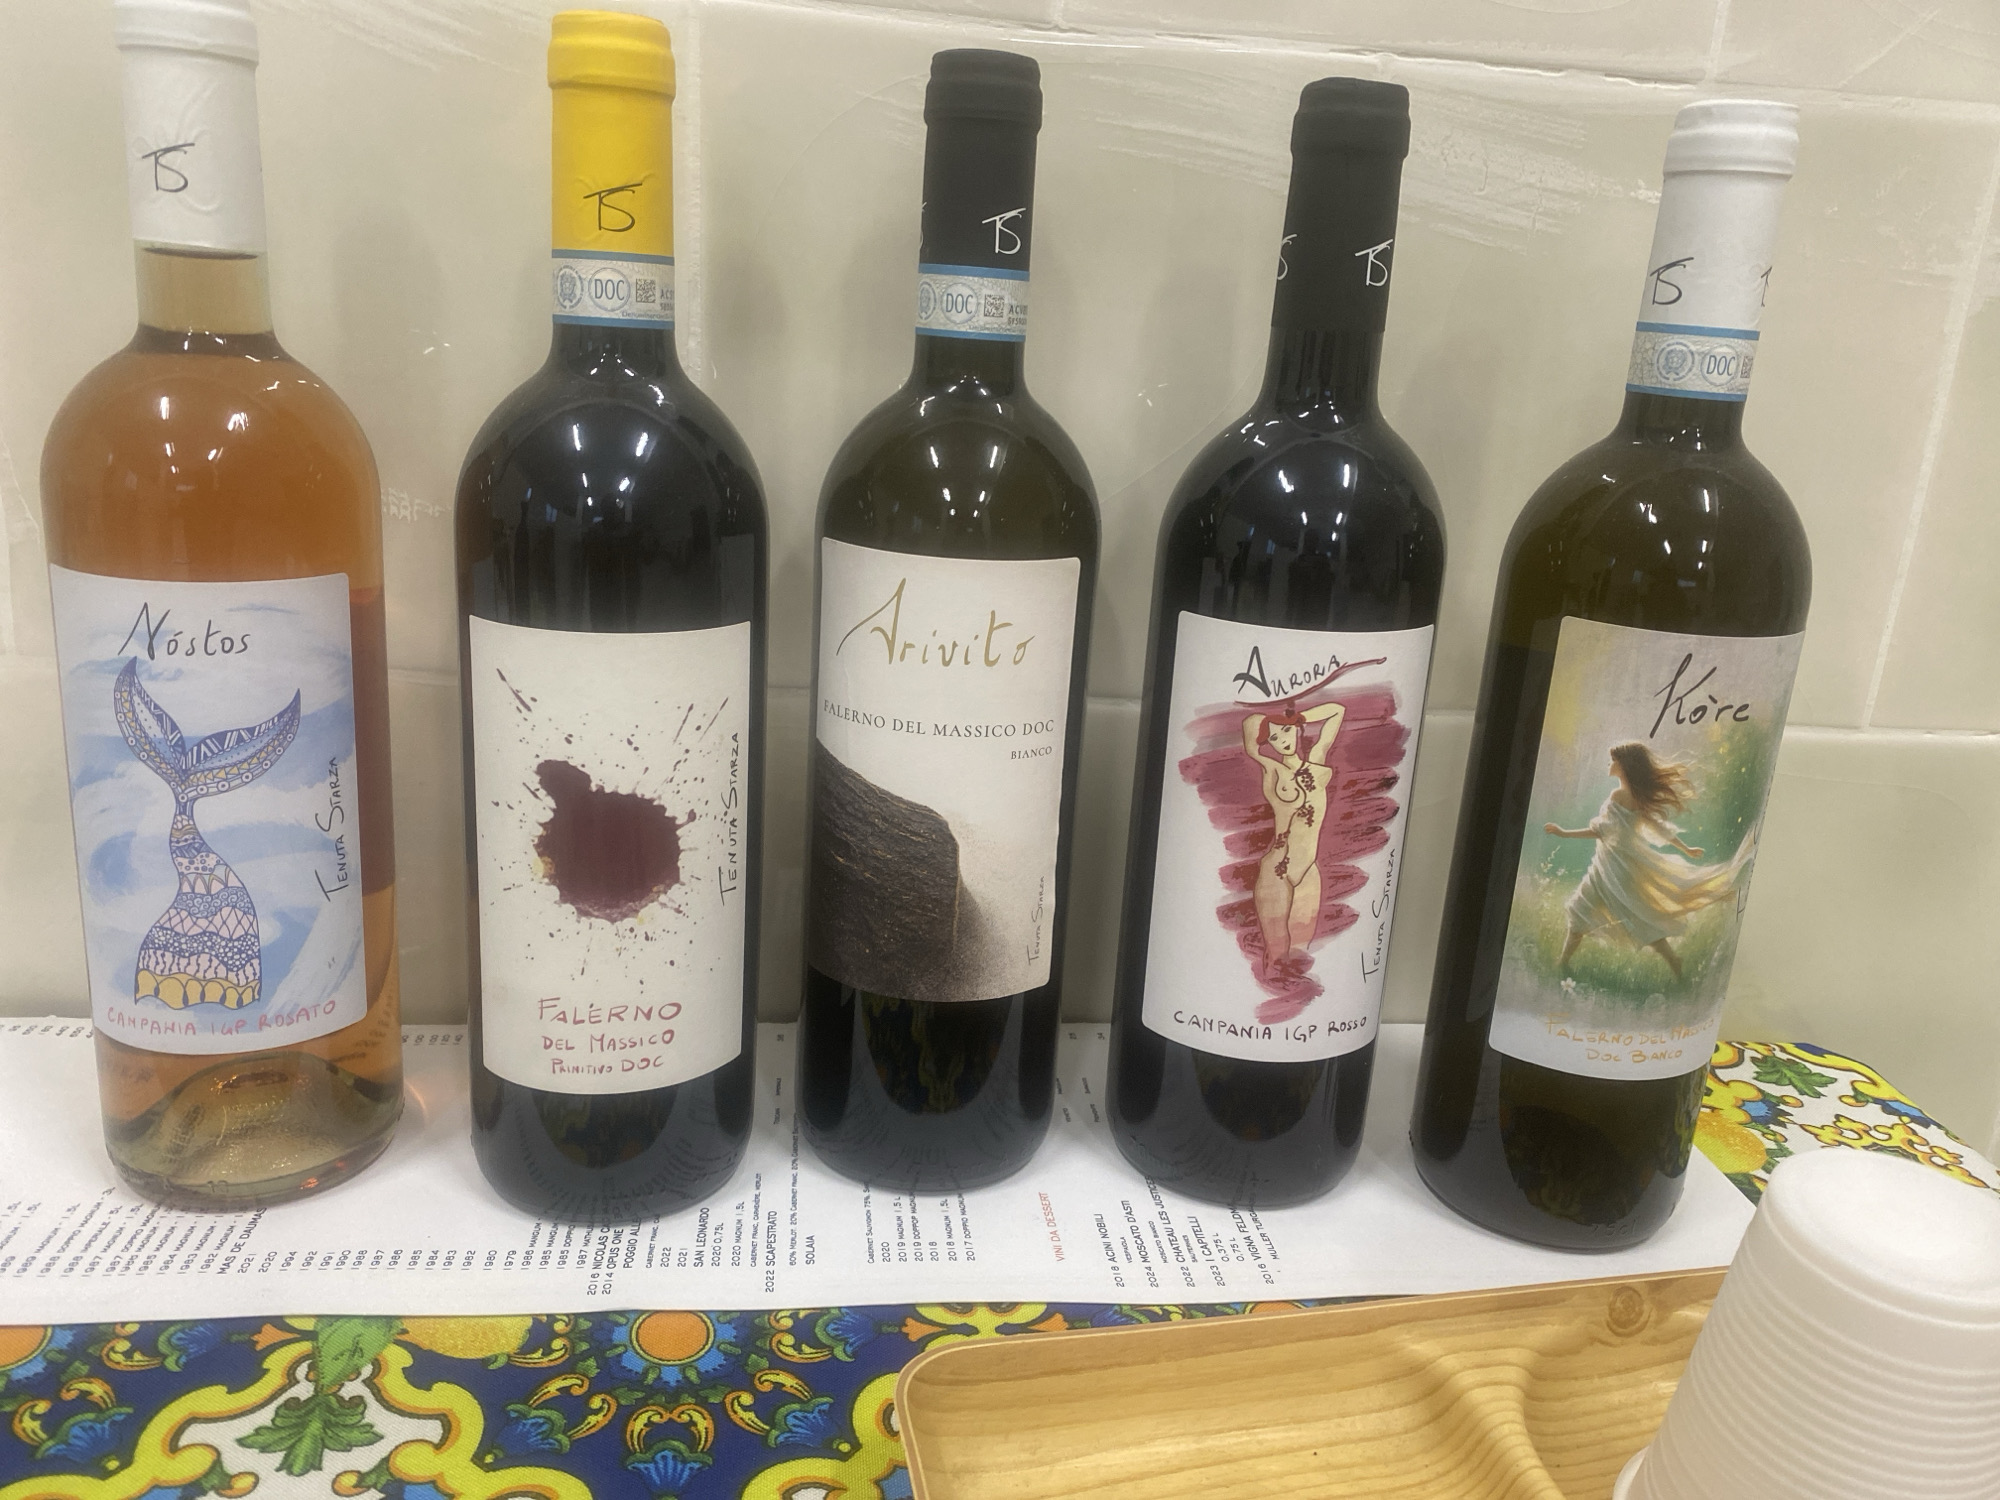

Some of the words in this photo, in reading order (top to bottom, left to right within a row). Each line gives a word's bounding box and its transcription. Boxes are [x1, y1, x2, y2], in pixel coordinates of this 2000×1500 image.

[594, 278, 625, 301] DOC
[945, 292, 974, 315] DOC
[1706, 354, 1736, 377] DOC
[118, 602, 252, 660] Nóstos
[836, 577, 1035, 668] Arivito
[823, 699, 887, 729] FALERNO
[892, 718, 926, 735] DEL
[933, 723, 1017, 740] MASSICO
[1022, 719, 1055, 736] DOC
[1010, 745, 1053, 760] BIANCO
[210, 1019, 247, 1036] IGP
[258, 1000, 337, 1032] ROSATO
[1285, 1026, 1318, 1043] IGP
[1327, 1016, 1368, 1035] ROSSO
[543, 1034, 576, 1052] DEL
[590, 1029, 675, 1053] MASSICO
[621, 1055, 665, 1073] DOC
[790, 1211, 798, 1226] 20%
[1038, 1191, 1057, 1228] DESSERT
[1121, 1200, 1137, 1223] D'ASTI
[1158, 1210, 1171, 1226] LES
[612, 1228, 624, 1245] ONE
[696, 1207, 710, 1248] LEONARDO
[735, 1219, 743, 1244] MAGNUM
[896, 1215, 905, 1240] MAGNUM
[944, 1215, 953, 1240] MAGNUM
[960, 1216, 972, 1239] DOPPIO
[1050, 1230, 1061, 1242] DA
[1093, 1213, 1110, 1239] NOBILI
[1148, 1220, 1159, 1239] BIANCO
[1187, 1216, 1212, 1257] CAPITELLI
[216, 1255, 237, 1275] MAS
[230, 1241, 246, 1254] DE
[239, 1207, 268, 1240] DAUMAS
[556, 1249, 570, 1269] 1985
[563, 1224, 576, 1247] DOPPIO
[766, 1210, 777, 1267] SCAPESTRATO
[1130, 1225, 1151, 1263] MOSCATO
[1163, 1227, 1186, 1263] CHATEAU
[1243, 1235, 1262, 1261] VIGNA
[1260, 1232, 1280, 1260] MULLER
[279, 1250, 298, 1271] 1994
[299, 1250, 318, 1271] 1992
[318, 1251, 336, 1270] 1991
[333, 1249, 352, 1270] 1990
[350, 1249, 368, 1270] 1988
[369, 1249, 385, 1270] 1987
[387, 1249, 403, 1270] 1986
[406, 1249, 423, 1270] 1985
[424, 1249, 440, 1270] 1984
[442, 1249, 458, 1270] 1983
[461, 1249, 476, 1270] 1982
[482, 1249, 498, 1271] 1980
[503, 1249, 517, 1271] 1979
[520, 1249, 535, 1270] 1986
[538, 1249, 553, 1270] 1985
[576, 1249, 588, 1269] 1987
[592, 1234, 609, 1270] NICOLAS
[606, 1246, 620, 1269] OPUS
[623, 1238, 638, 1268] POGGIO
[646, 1243, 656, 1268] CABERNET
[660, 1246, 672, 1267] 2022
[677, 1247, 688, 1267] 2021
[694, 1250, 704, 1267] SAN
[711, 1246, 722, 1267] 2020
[731, 1245, 741, 1267] 2020
[750, 1241, 758, 1267] CABERNET
[789, 1251, 797, 1266] 60%
[805, 1235, 815, 1265] SOLAIA
[867, 1238, 875, 1264] CABERNET
[881, 1241, 890, 1263] 2020
[897, 1241, 907, 1262] 2019
[914, 1241, 923, 1262] 2019
[929, 1241, 939, 1262] 2018
[946, 1241, 957, 1262] 2018
[964, 1240, 976, 1261] 2017
[1053, 1244, 1065, 1262] VINI
[1102, 1241, 1117, 1263] ACINI
[1155, 1239, 1169, 1264] MOSCATO
[157, 1253, 177, 1275] 1984
[198, 1252, 218, 1274] 1982
[237, 1253, 257, 1274] 2021
[258, 1251, 278, 1273] 2020
[587, 1272, 600, 1295] 2016
[602, 1272, 615, 1295] 2014
[765, 1270, 775, 1293] 2022
[1111, 1265, 1125, 1288] 2018
[1145, 1266, 1159, 1288] 2024
[1180, 1266, 1196, 1288] 2022
[1209, 1265, 1226, 1287] 2023
[1258, 1263, 1275, 1285] 2016
